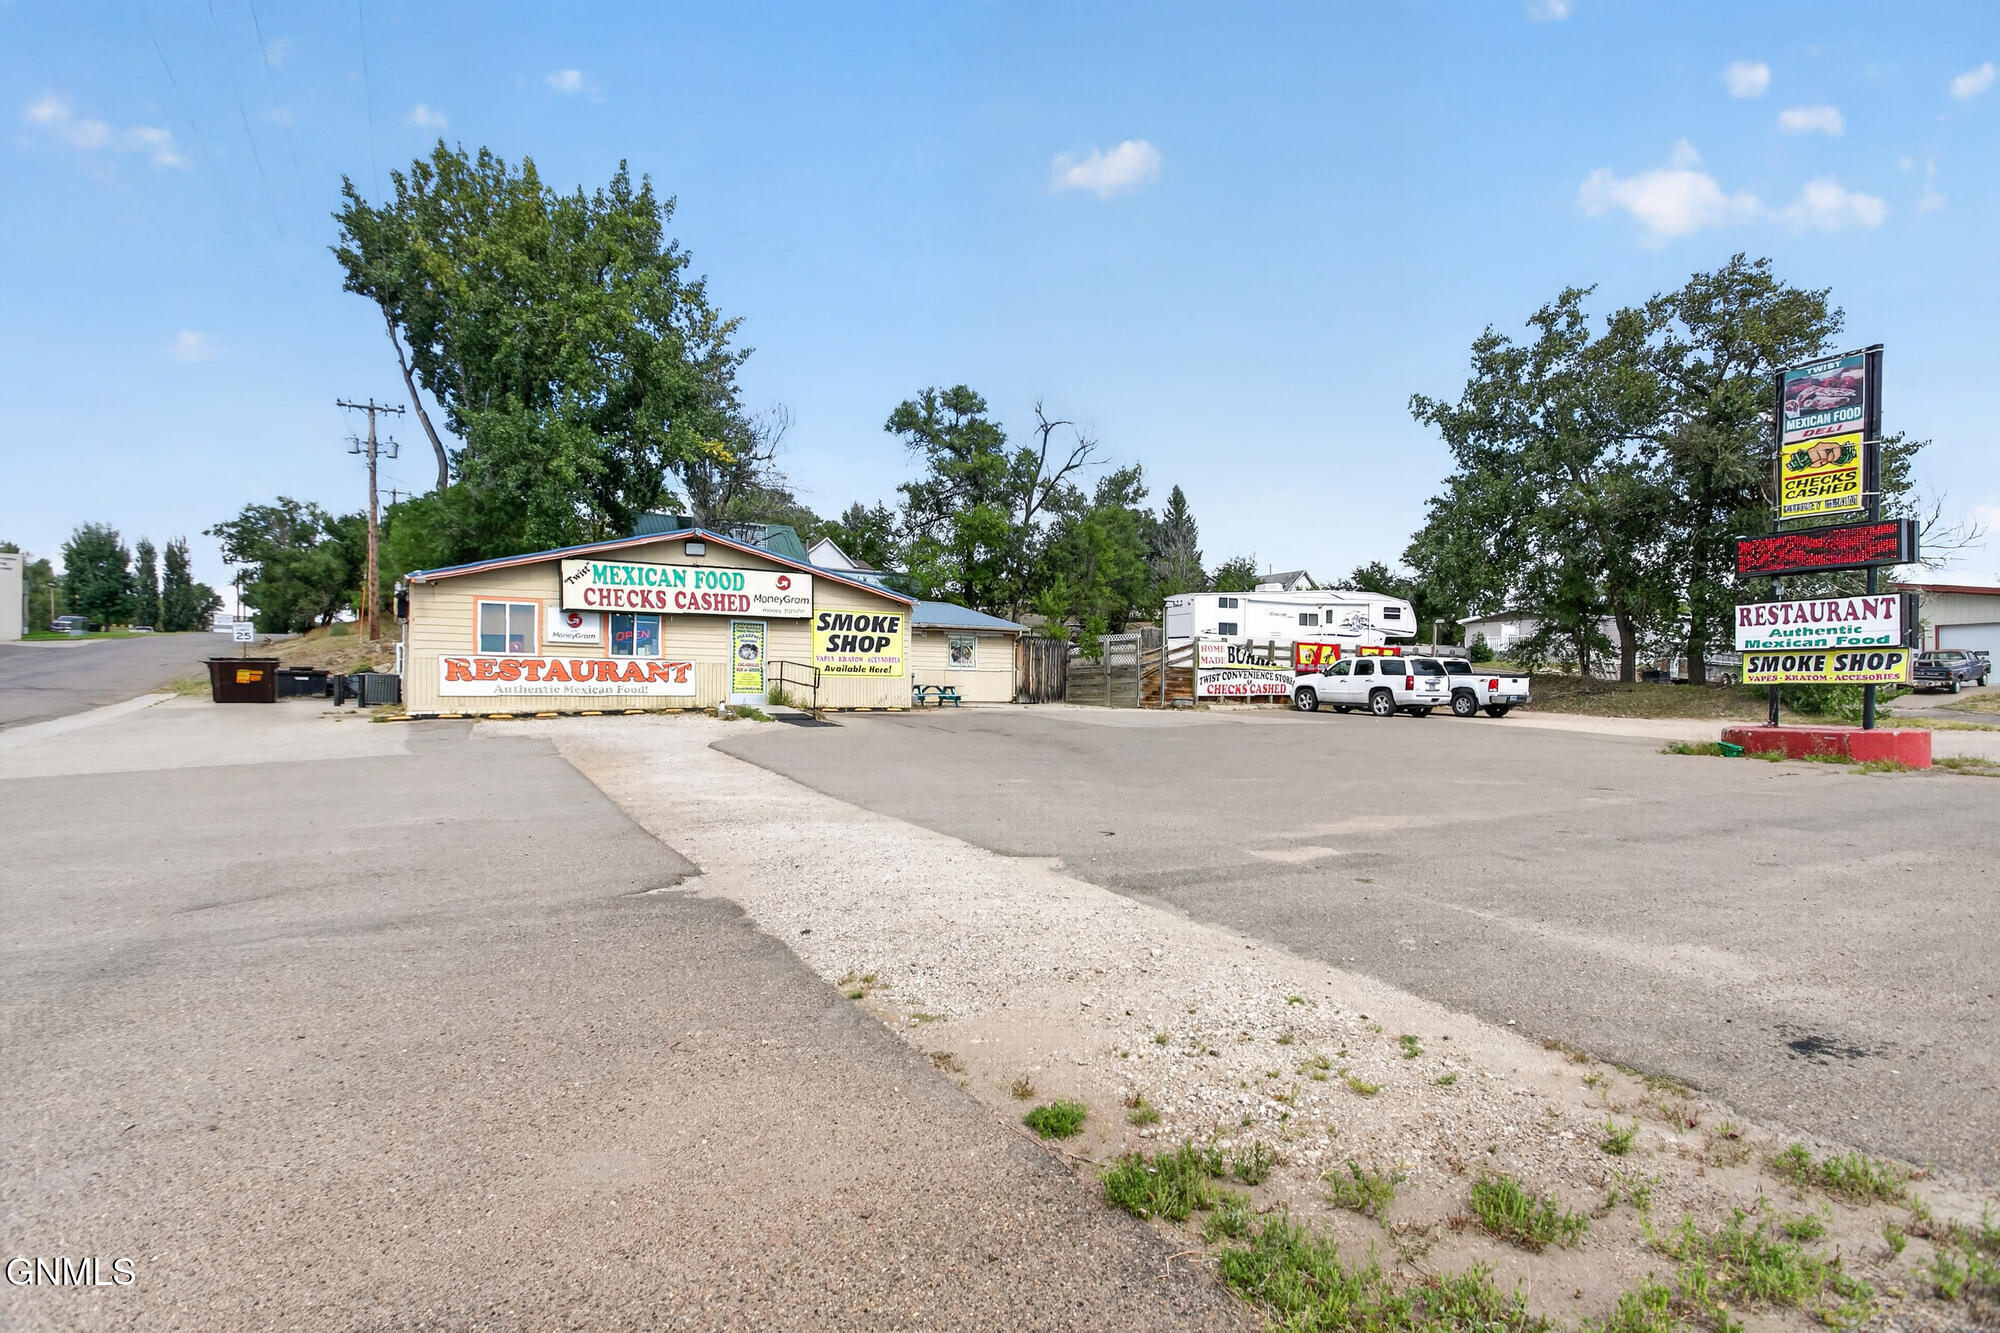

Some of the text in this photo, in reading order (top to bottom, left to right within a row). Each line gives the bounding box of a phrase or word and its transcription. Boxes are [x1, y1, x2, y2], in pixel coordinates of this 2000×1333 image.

[1806, 361, 1842, 375] TWIST
[1786, 406, 1861, 432] MEXICAN FOOD
[1802, 424, 1843, 438] DELI
[1785, 471, 1858, 490] CHECKS
[1785, 482, 1858, 500] CASHED
[592, 563, 745, 591] MEXICAN FOOD
[583, 587, 751, 612] CHECKS CASHED
[753, 594, 810, 605] MoneyGram
[1738, 597, 1896, 627] RESTAURANT
[816, 612, 901, 633] SMOKE
[236, 632, 251, 640] 25
[552, 632, 597, 640] MoneyGram
[615, 629, 650, 642] OPEN
[1768, 624, 1863, 638] Authentic
[826, 634, 891, 653] SHOP
[1744, 634, 1891, 649] Mexican Food
[1201, 645, 1225, 653] HOME
[815, 655, 835, 663] VAPES
[1201, 656, 1226, 665] MADE
[1747, 652, 1903, 673] SMOKE SHOP
[444, 658, 692, 683] RESTAURANT
[824, 664, 892, 674] Available Here!
[1200, 673, 1221, 686] TWIST
[1222, 670, 1273, 681] CONVENIENCE
[493, 684, 648, 694] Authentic Mexican Food!
[1207, 684, 1287, 695] CHECKS CASHED
